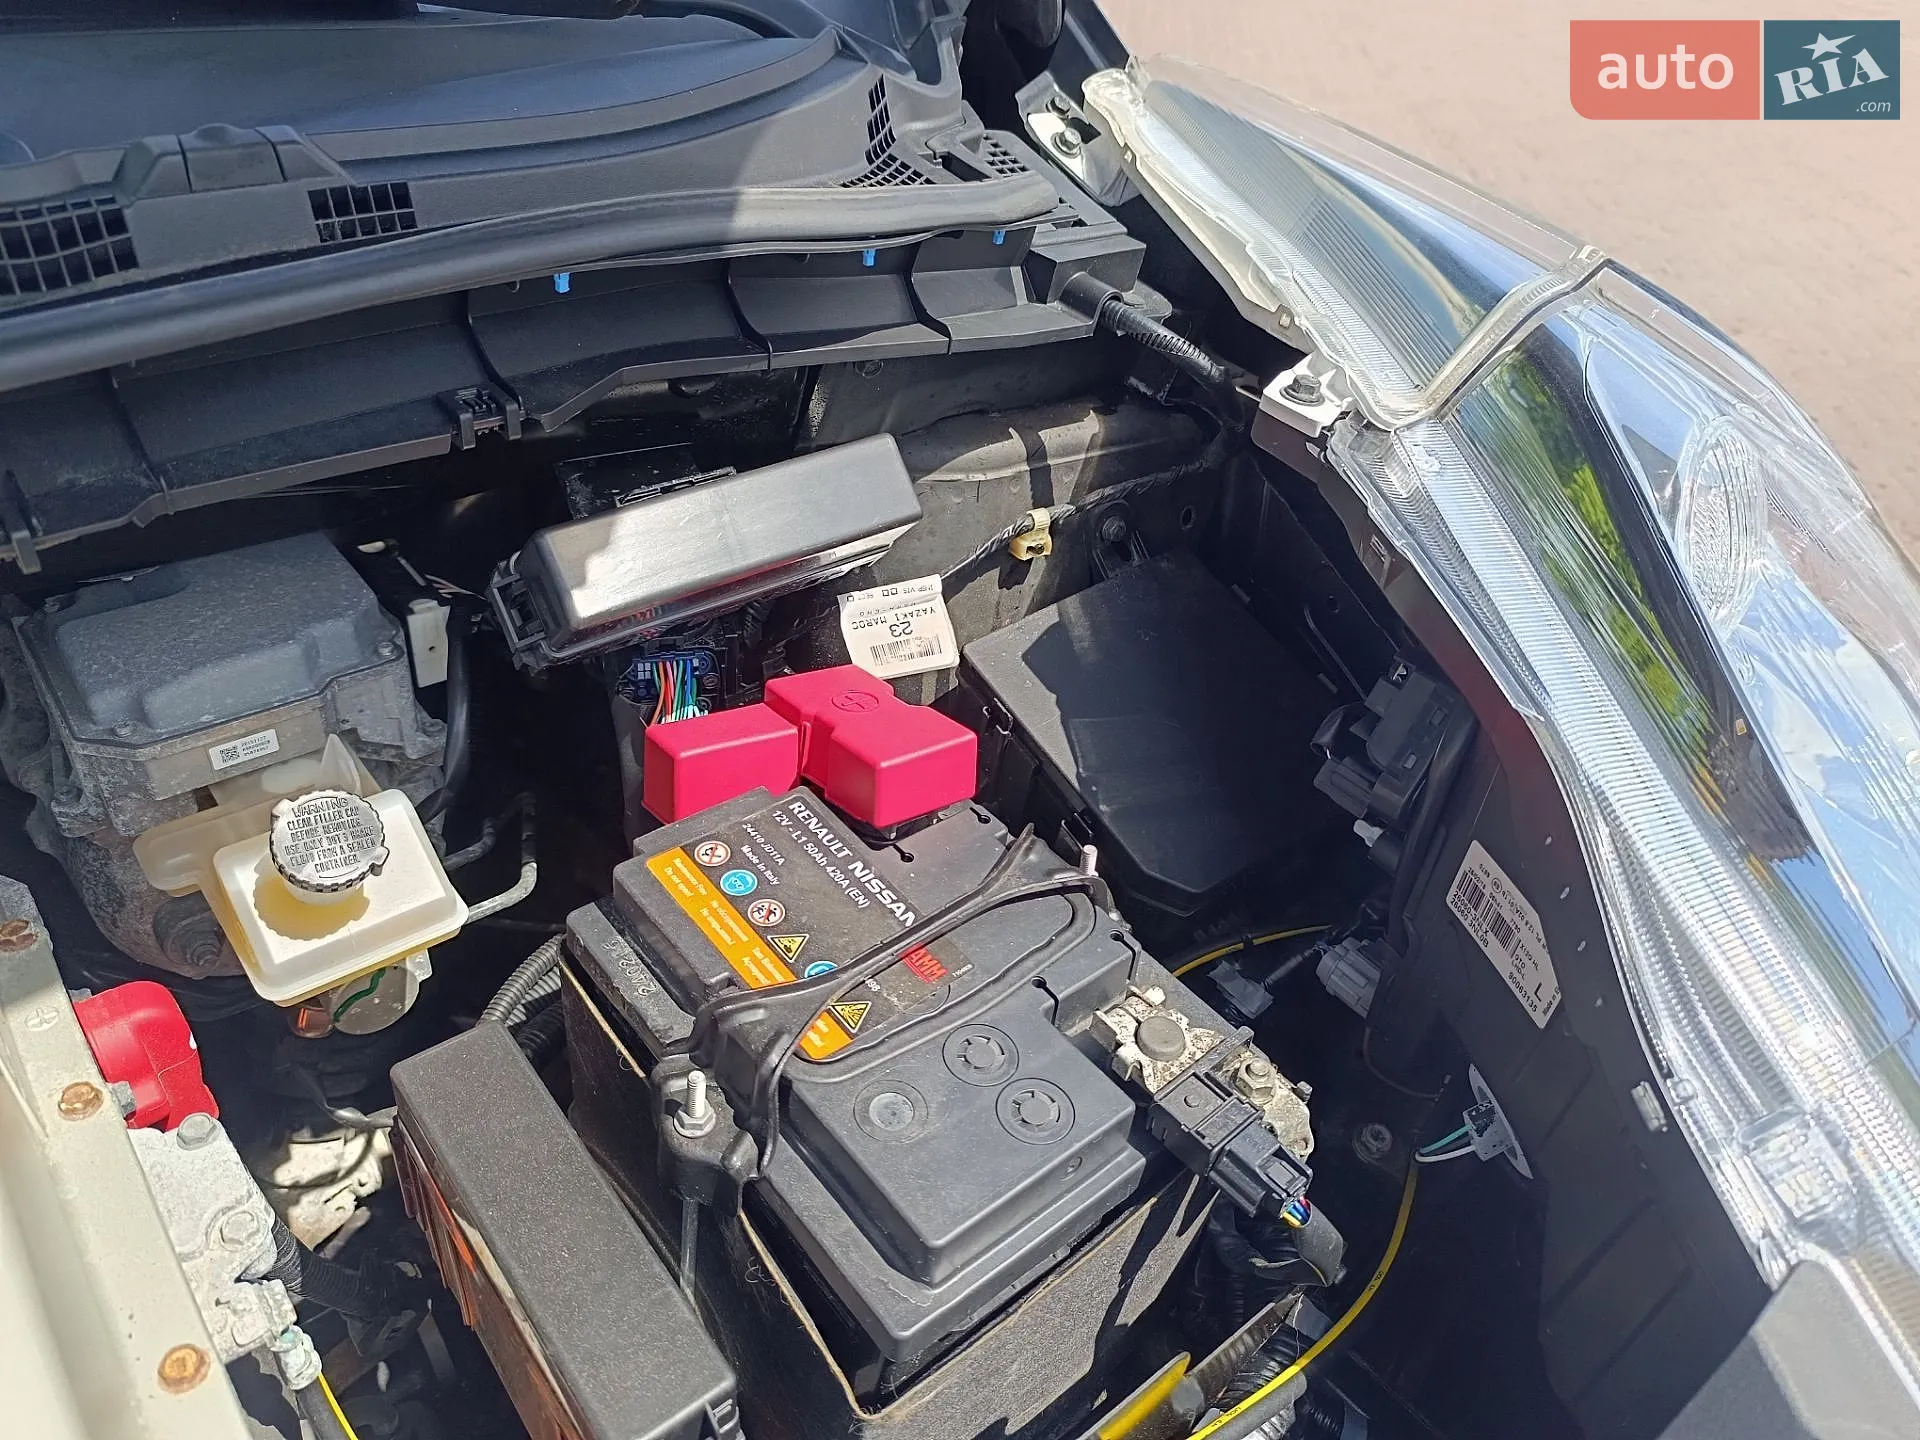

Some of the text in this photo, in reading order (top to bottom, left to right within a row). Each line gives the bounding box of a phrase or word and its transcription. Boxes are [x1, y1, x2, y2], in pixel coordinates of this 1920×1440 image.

[851, 615, 886, 629] MAROC
[894, 606, 935, 621] YAZAKI
[888, 620, 913, 638] 23
[292, 795, 348, 818] WARNING
[313, 809, 343, 824] FILLER
[344, 805, 359, 817] CAP
[290, 826, 320, 842] BEFORE
[740, 822, 764, 844] 24410
[284, 843, 301, 856] USE
[303, 837, 323, 851] ONLY
[290, 836, 377, 867] FLUID FROM A SEALED
[739, 844, 781, 887] Made in Italy
[770, 810, 792, 828] 12V
[790, 830, 808, 845] L1
[801, 842, 829, 866] 50Ah
[823, 864, 850, 889] 420A
[843, 885, 871, 909] (EN)
[787, 800, 919, 926] RENAULT NISSAN
[1506, 971, 1538, 1012] 90063135
[1533, 982, 1542, 1002] L
